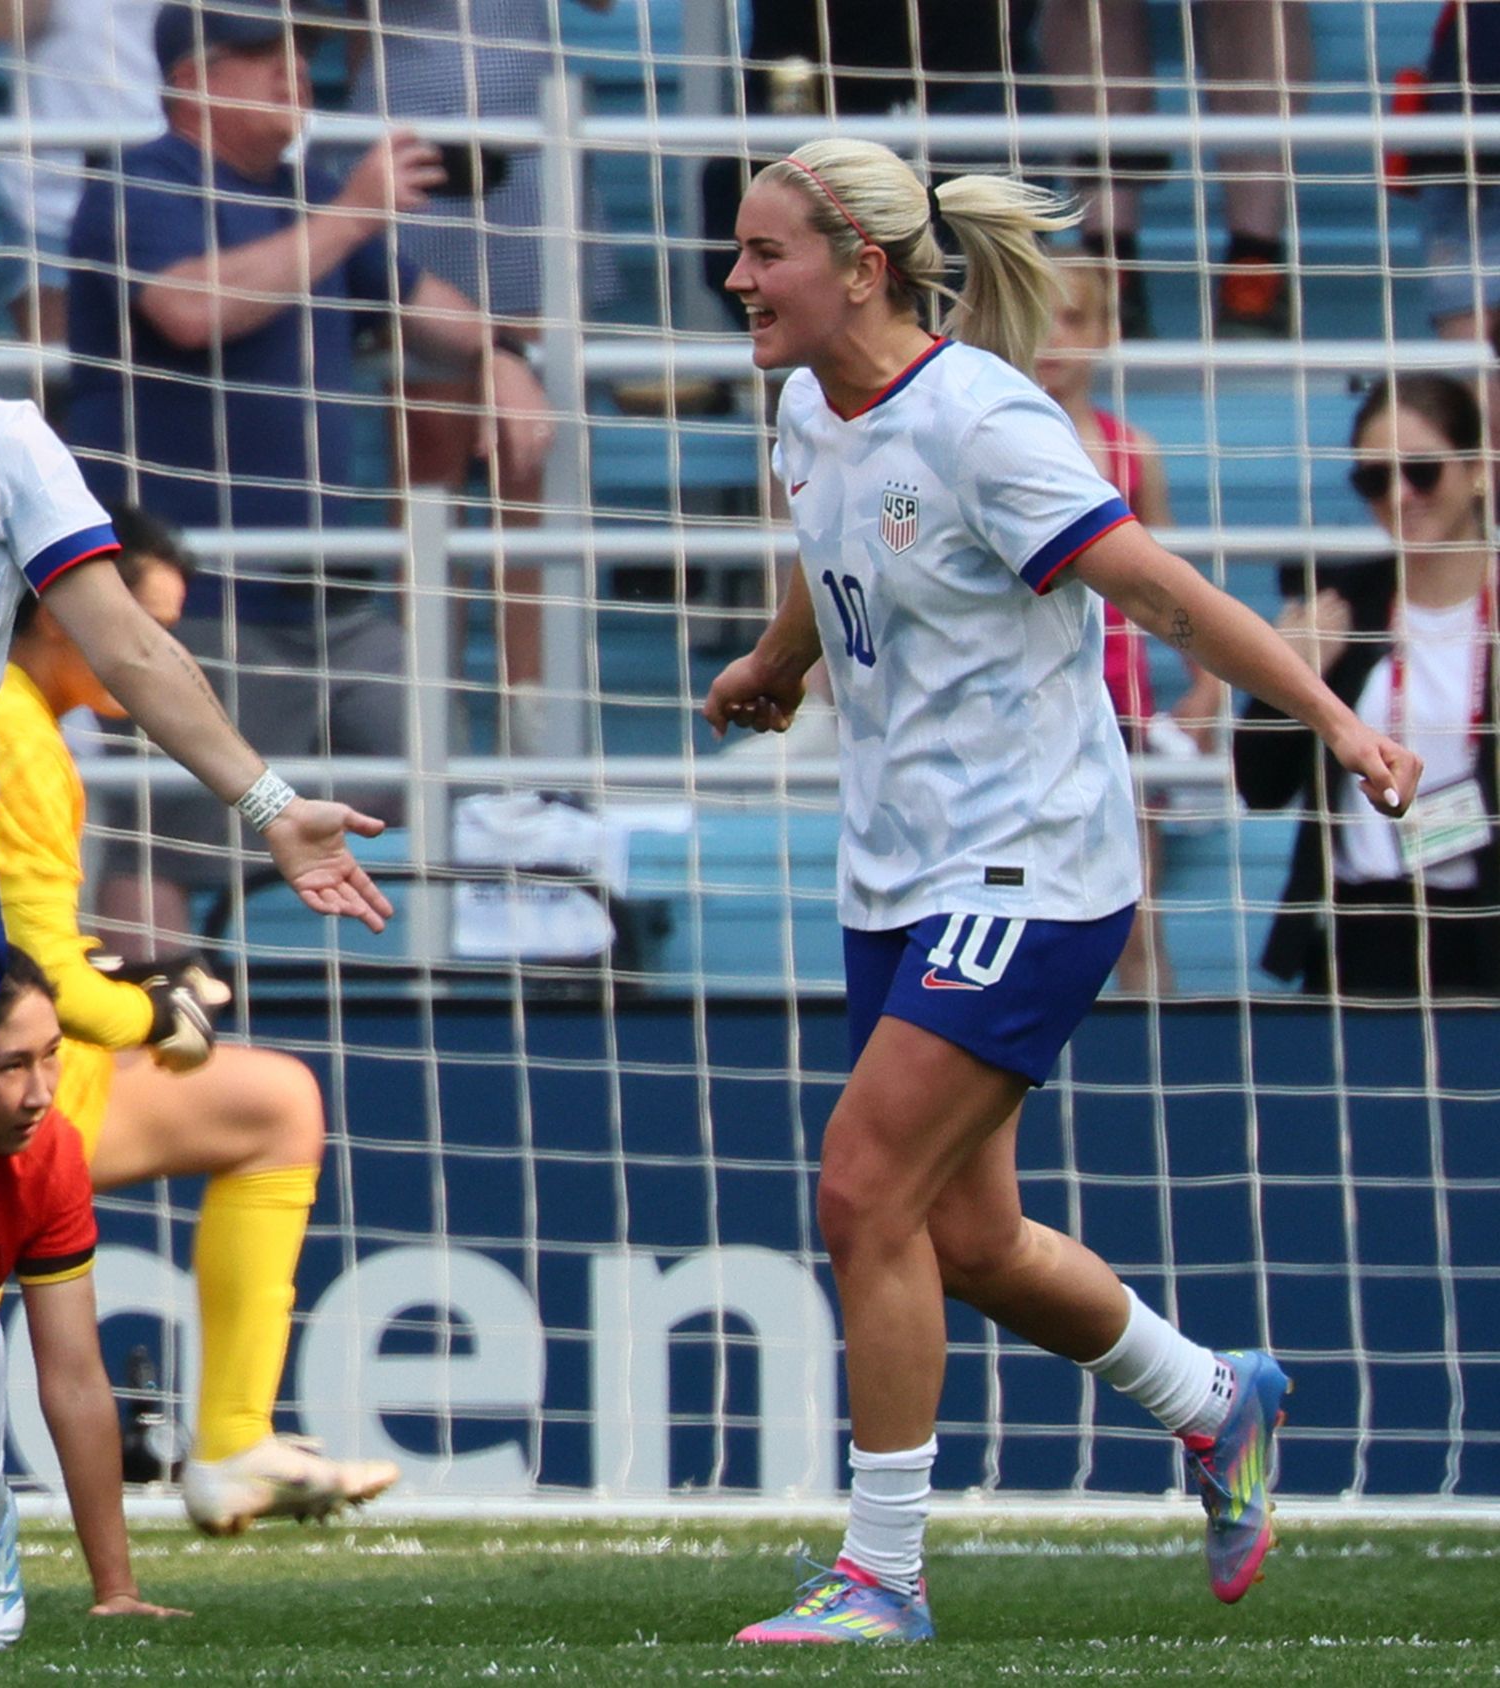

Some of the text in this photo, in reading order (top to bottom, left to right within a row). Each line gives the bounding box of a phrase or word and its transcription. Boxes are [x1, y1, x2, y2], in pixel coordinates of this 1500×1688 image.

[884, 494, 916, 521] USA
[822, 569, 877, 669] 10
[926, 912, 1027, 987] 10
